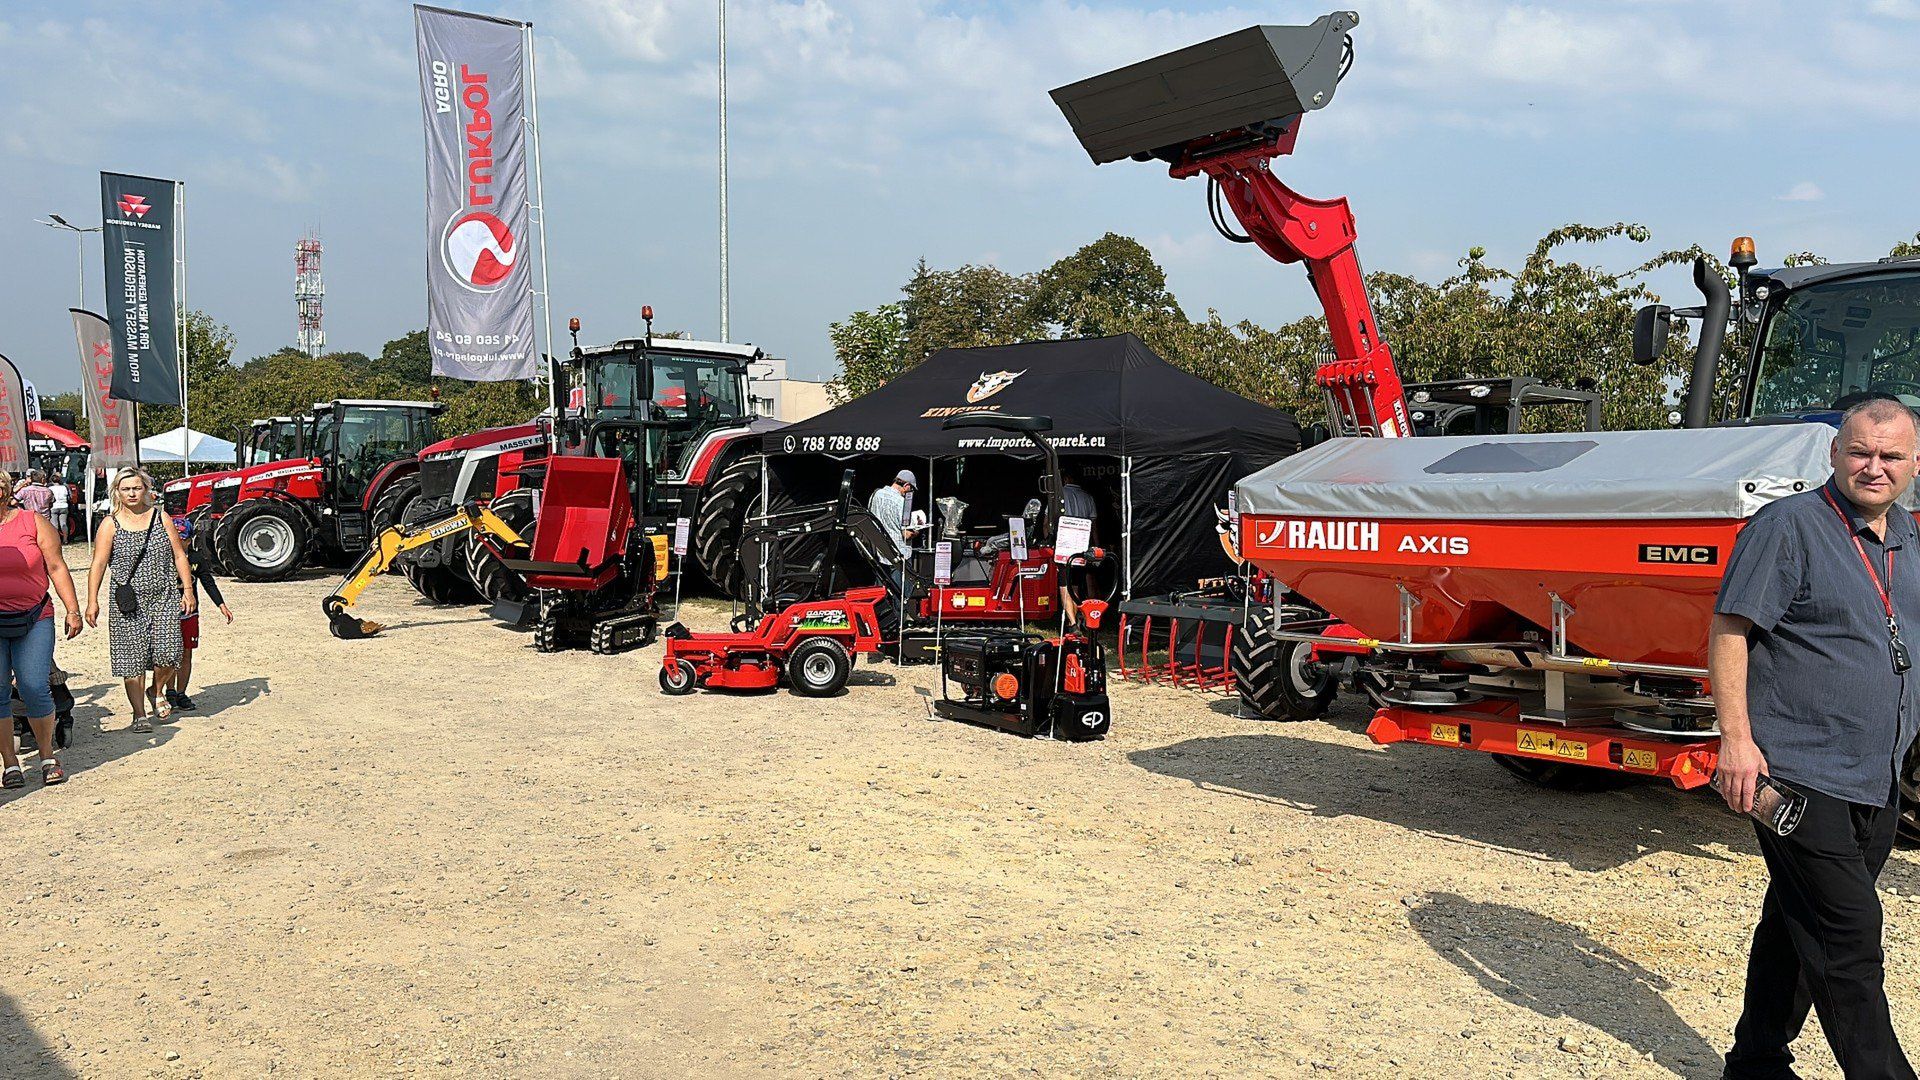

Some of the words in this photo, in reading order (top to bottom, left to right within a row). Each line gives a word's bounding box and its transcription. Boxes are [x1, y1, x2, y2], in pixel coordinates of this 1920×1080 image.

[499, 438, 533, 452] MASSEY
[802, 436, 825, 452] 788
[828, 435, 853, 451] 788
[855, 436, 881, 452] 888
[430, 517, 468, 538] KINGWAY
[1288, 520, 1380, 551] RAUCH
[1397, 535, 1470, 555] AXIS
[1646, 546, 1709, 563] EMC
[1081, 711, 1104, 729] EP
